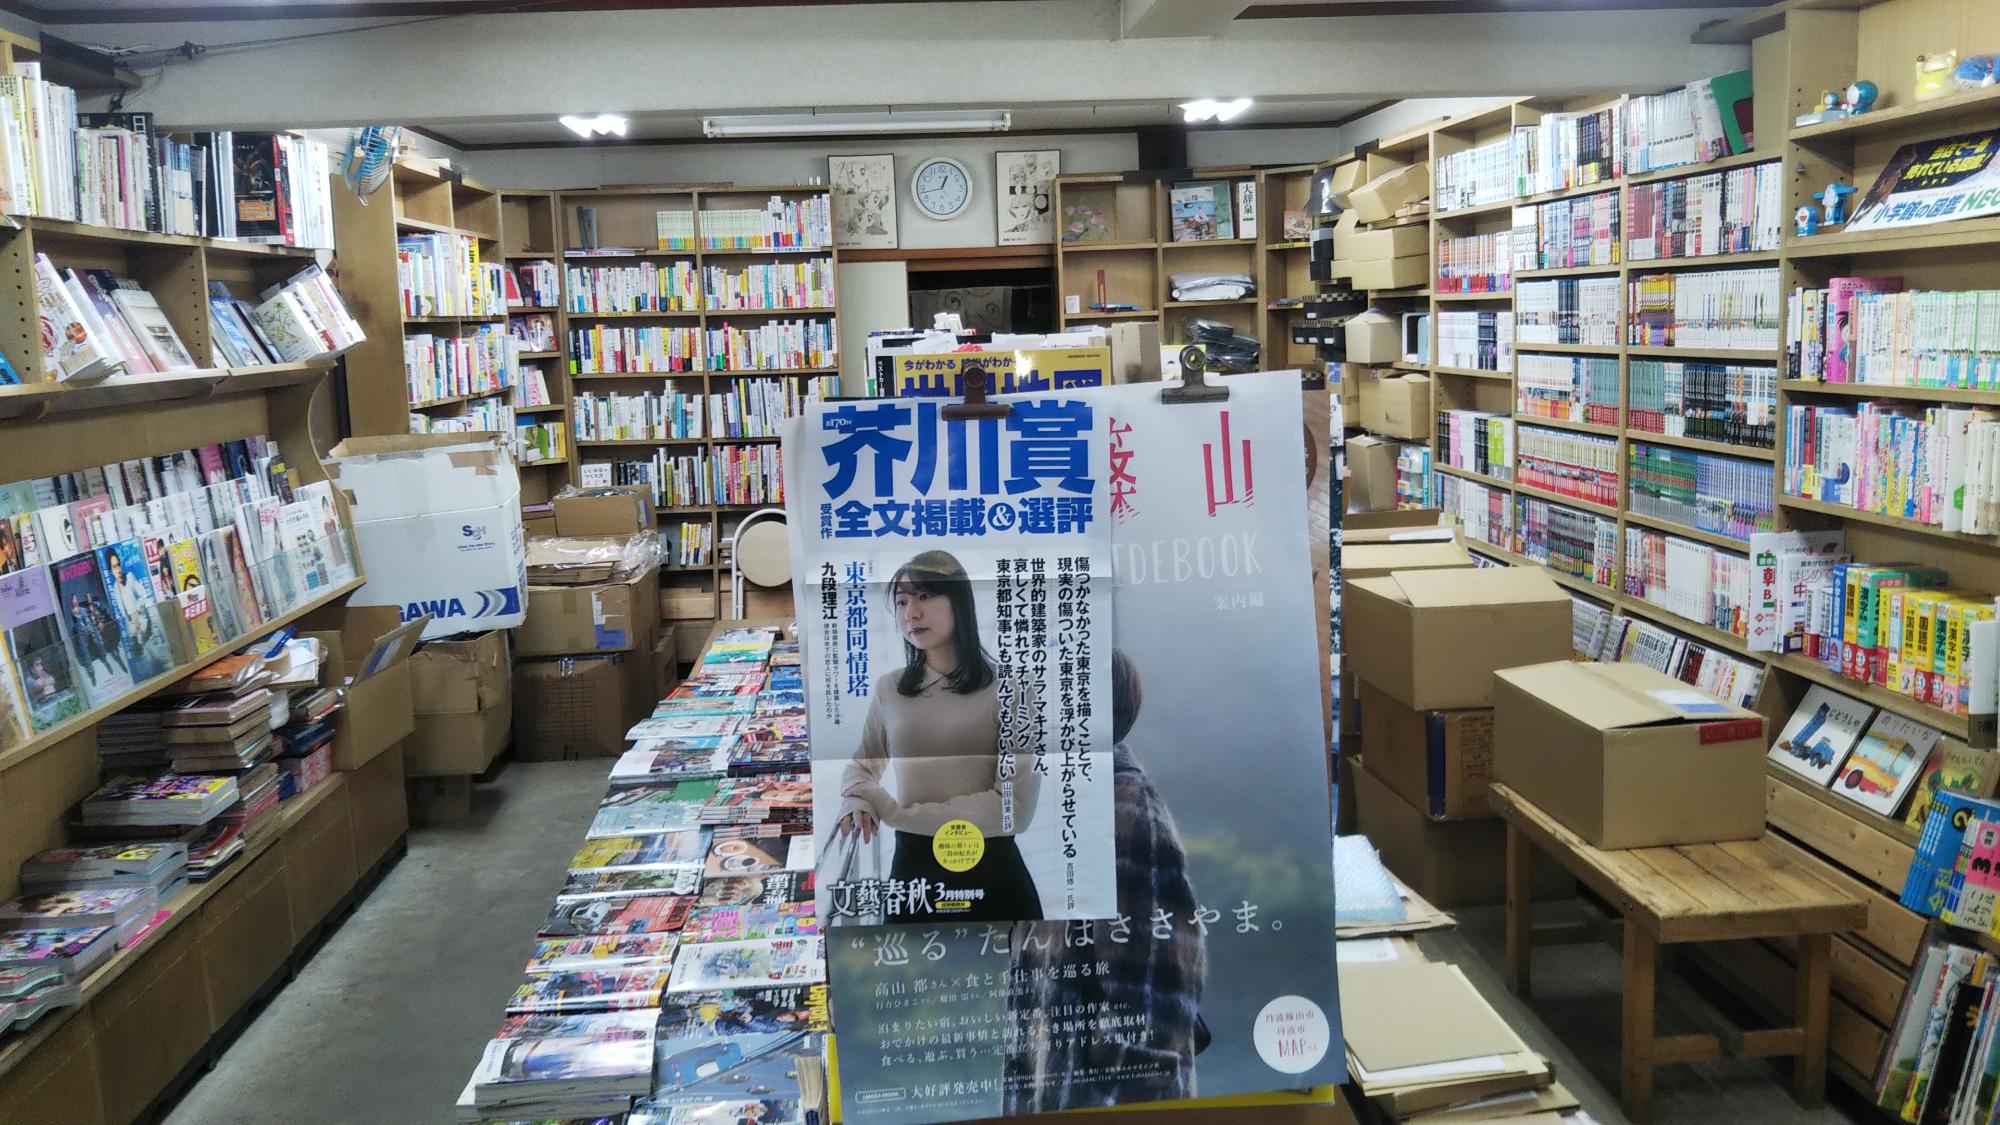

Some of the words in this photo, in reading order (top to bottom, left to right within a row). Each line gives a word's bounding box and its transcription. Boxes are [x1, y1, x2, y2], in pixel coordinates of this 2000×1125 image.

[903, 359, 956, 371] 今がわかる
[821, 400, 1095, 499] 芥川賞
[820, 503, 832, 540] 受賞作
[821, 561, 838, 620] 九段理江
[844, 560, 869, 698] 東京都同情塔
[996, 558, 1015, 778] 東京都知事にも読んでもらいたい
[1057, 557, 1077, 859] 現実の傷ついた東京を浮かび上がらせている
[1074, 556, 1093, 783] 傷つかなかった東京を描くことで、
[827, 877, 934, 919] 文藝春秋
